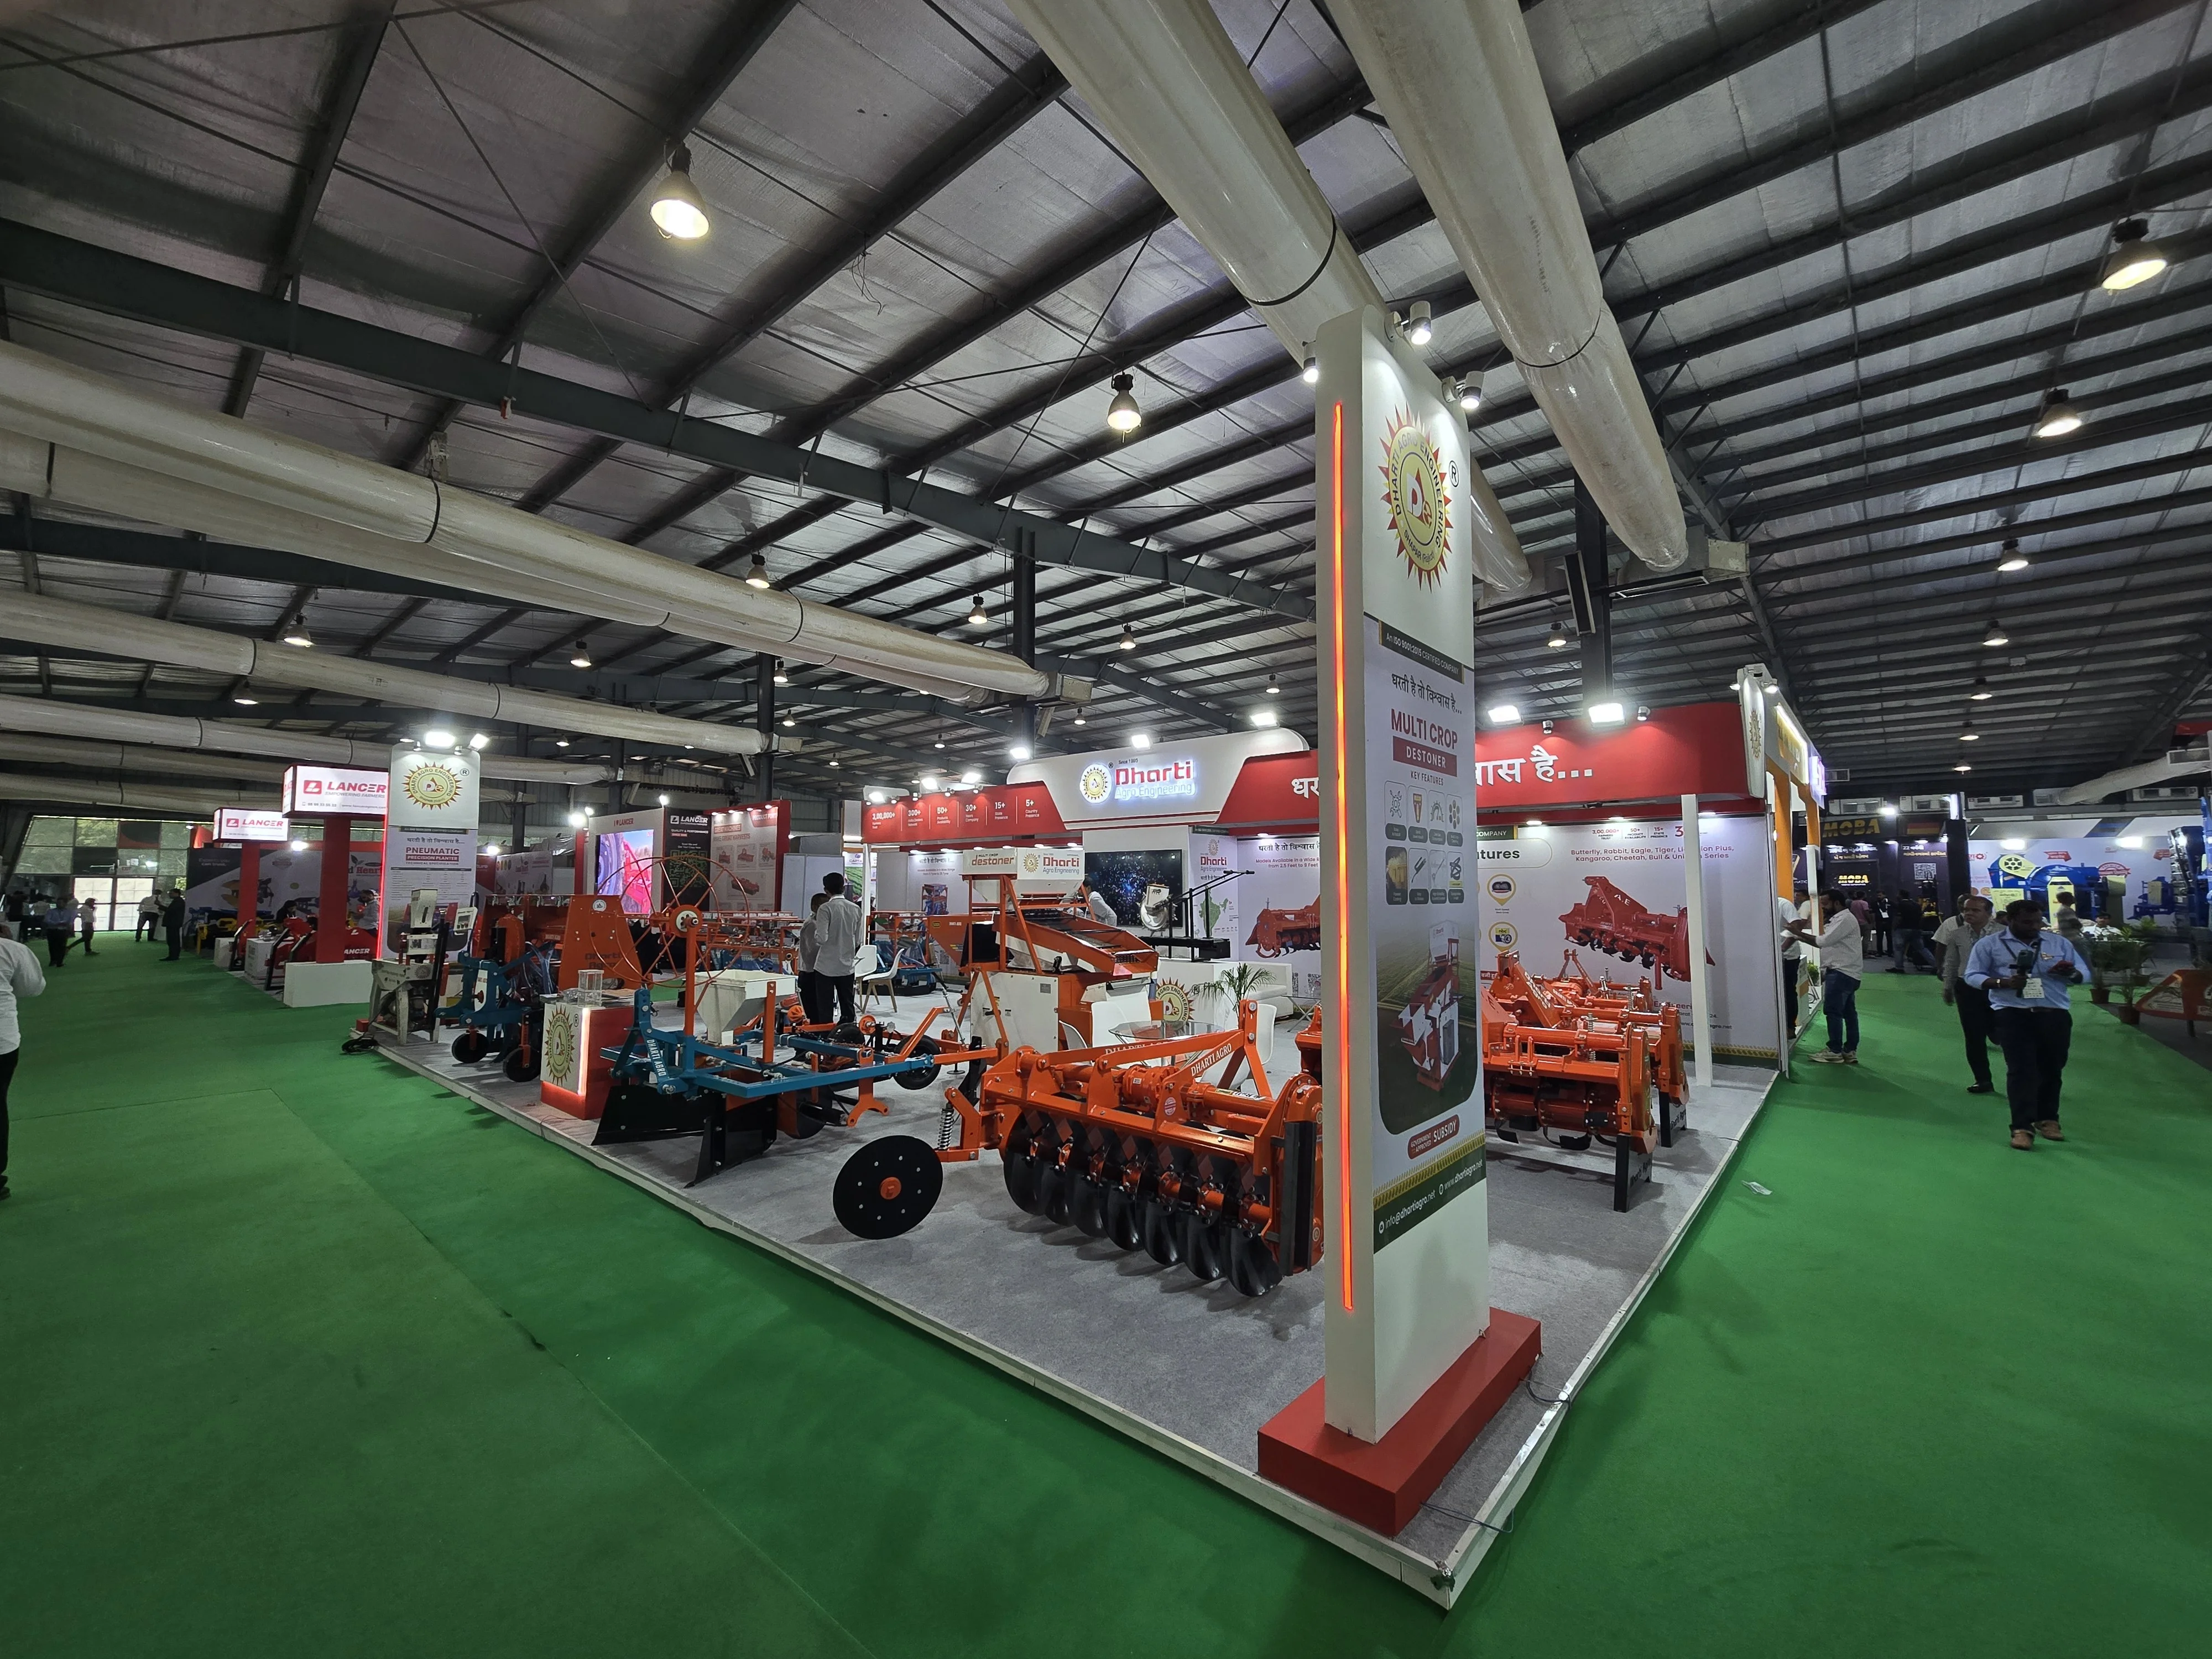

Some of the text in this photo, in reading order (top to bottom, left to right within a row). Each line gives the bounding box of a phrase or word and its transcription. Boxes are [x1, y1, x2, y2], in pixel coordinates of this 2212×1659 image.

[1392, 448, 1401, 517] DHARTI
[1420, 441, 1443, 549] ENGINEERING
[1386, 633, 1392, 643] An
[1401, 639, 1422, 656] 9001:2015
[1422, 650, 1441, 667] CERTIFIED
[1441, 659, 1459, 675] COMPANY
[1392, 673, 1410, 693] धरती
[1410, 675, 1416, 697] है
[1417, 680, 1425, 700] तो
[1426, 685, 1451, 710] विश्वास
[1391, 708, 1458, 750] MULTI CROP
[1406, 745, 1446, 769] DESTONER
[418, 768, 433, 776] AGRO
[435, 769, 455, 796] ENGINEERING
[1115, 761, 1192, 786] Dharti
[1410, 770, 1444, 786] KEY FEATURES
[327, 781, 387, 794] LANCER
[1116, 783, 1192, 800] Agro Engineering
[937, 806, 948, 815] 50+
[619, 818, 634, 826] LANCER
[1822, 818, 1880, 838] MOBA
[1275, 842, 1280, 851] है
[1281, 842, 1288, 851] तो
[1289, 842, 1314, 851] विश्वास
[972, 854, 1014, 866] destoner
[1043, 856, 1079, 867] Dharti
[1201, 856, 1227, 866] Dharti
[1055, 867, 1079, 875] Engineering
[1838, 874, 1870, 884] MOBA
[1157, 986, 1188, 1022] AGRO ENGINEERING
[646, 1039, 667, 1077] DHARTI AGRO
[1191, 1042, 1232, 1077] DHARTI AGRO
[1410, 1119, 1457, 1148] GOVERNMENT SUBSIDY
[1415, 1139, 1432, 1152] APPROVED
[1385, 1159, 1483, 1229] info@dhartiagro.net www.dhartiagro.net
